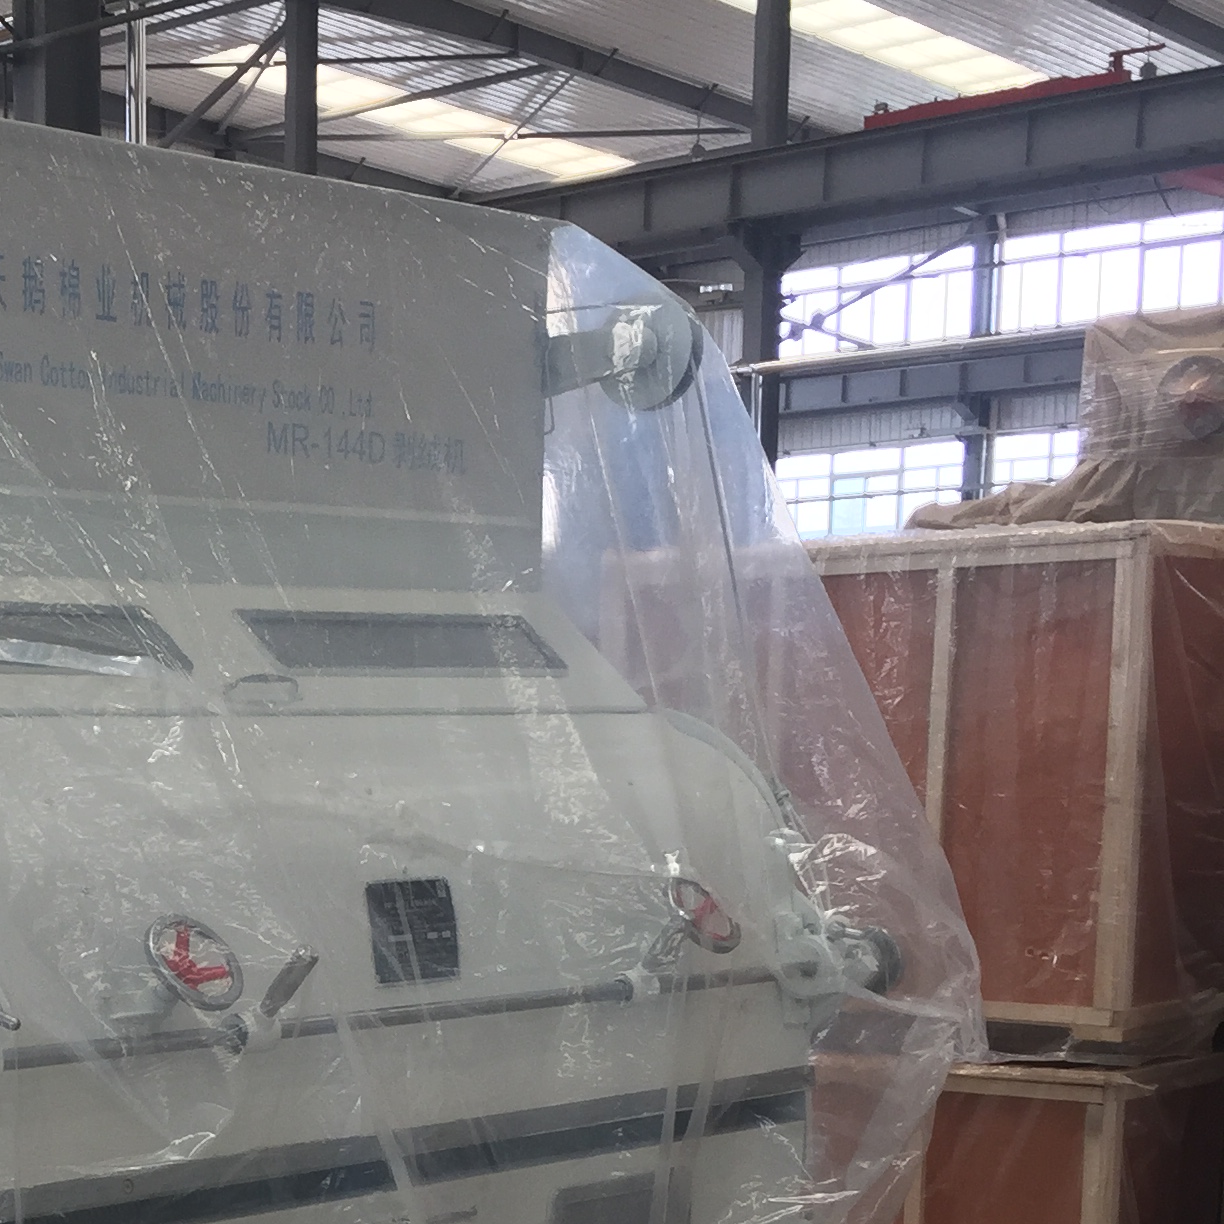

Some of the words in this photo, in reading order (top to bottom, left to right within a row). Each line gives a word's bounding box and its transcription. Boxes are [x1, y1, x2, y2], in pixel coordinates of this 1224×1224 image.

[192, 372, 266, 413] Machinery
[272, 380, 311, 411] Stock
[267, 421, 386, 464] MR-144D
